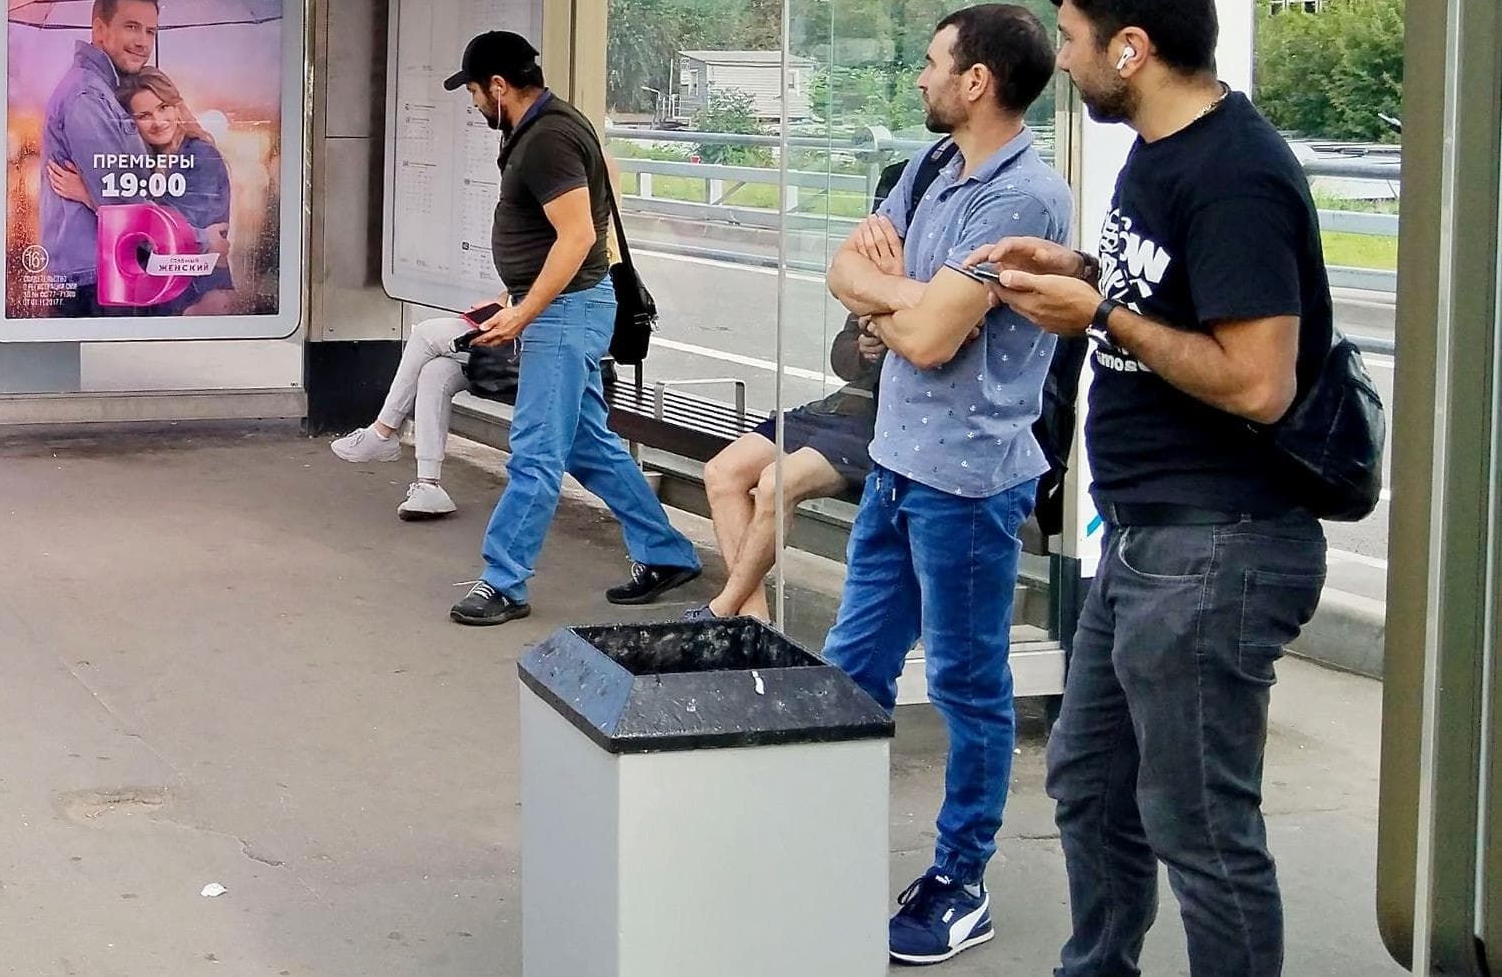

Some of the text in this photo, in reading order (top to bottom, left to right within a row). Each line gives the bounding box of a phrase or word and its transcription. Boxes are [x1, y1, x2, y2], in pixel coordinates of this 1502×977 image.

[93, 154, 195, 169] ПРЕМЬЕРЫ
[101, 172, 187, 197] 19:00
[25, 251, 47, 268] 16+
[158, 262, 210, 272] ЖЕНСКИЙ
